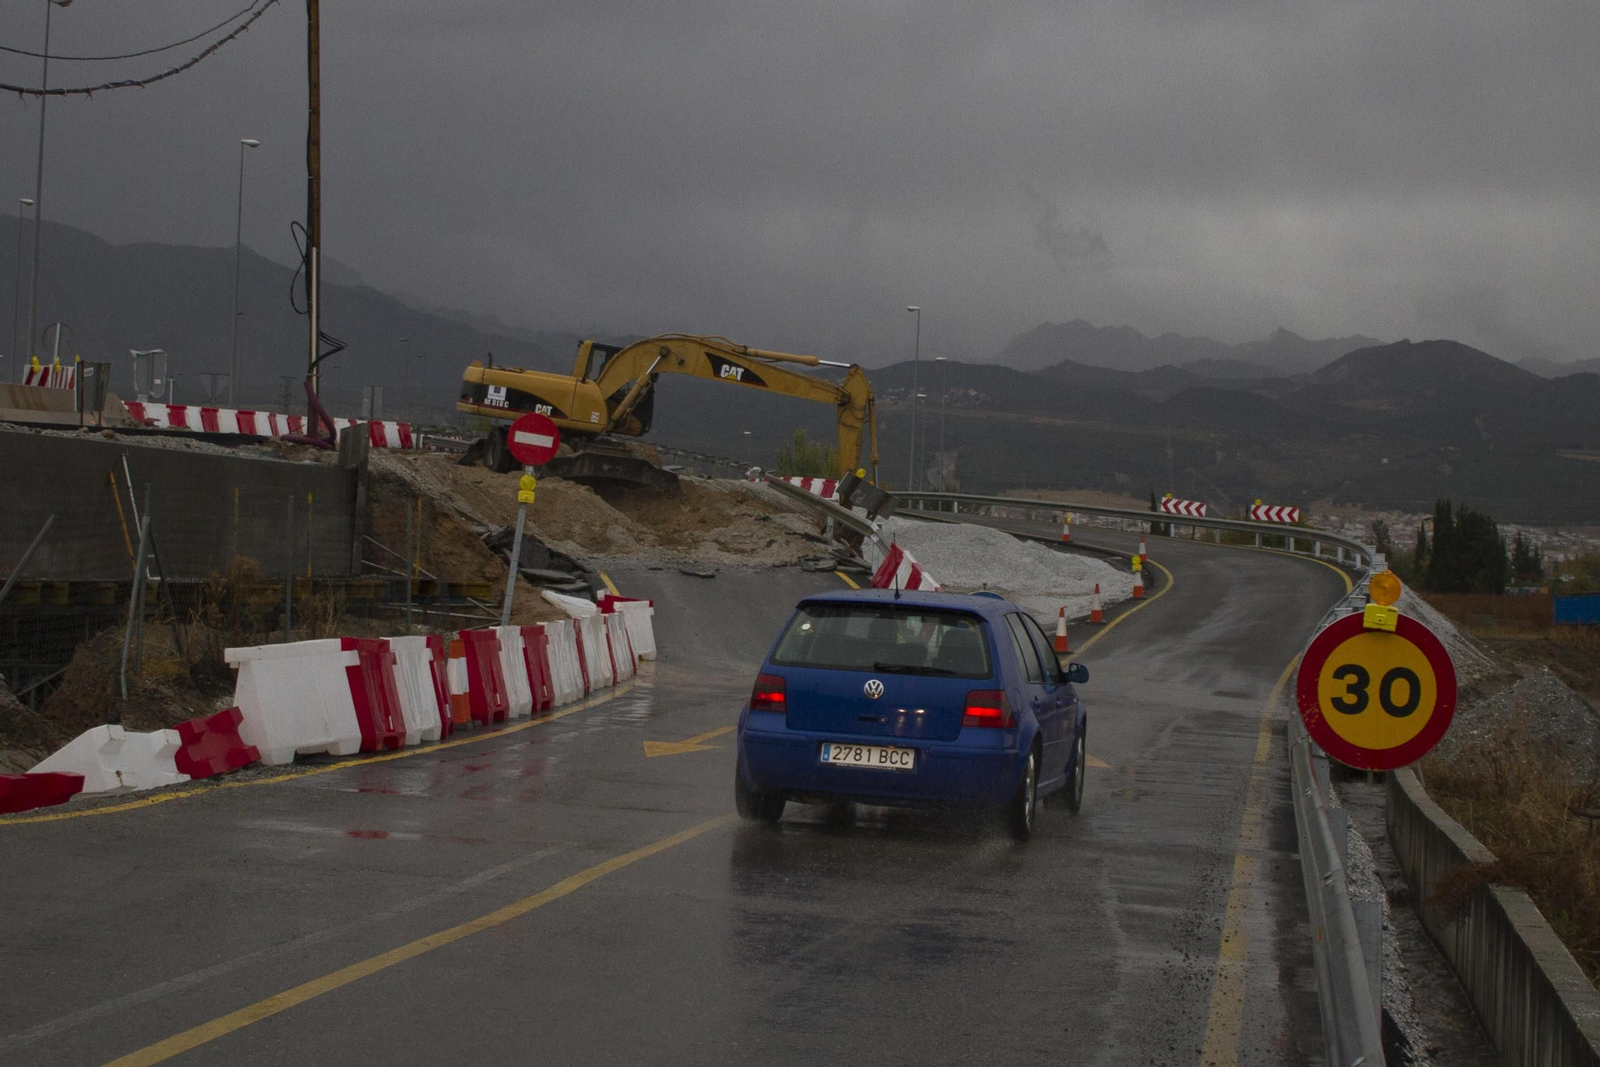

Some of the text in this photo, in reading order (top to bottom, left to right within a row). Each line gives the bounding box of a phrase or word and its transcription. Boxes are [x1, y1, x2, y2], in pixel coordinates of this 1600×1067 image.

[720, 364, 744, 381] CAT
[535, 403, 553, 416] CAT
[1330, 664, 1421, 718] 30
[832, 745, 910, 766] 2781 BCC
